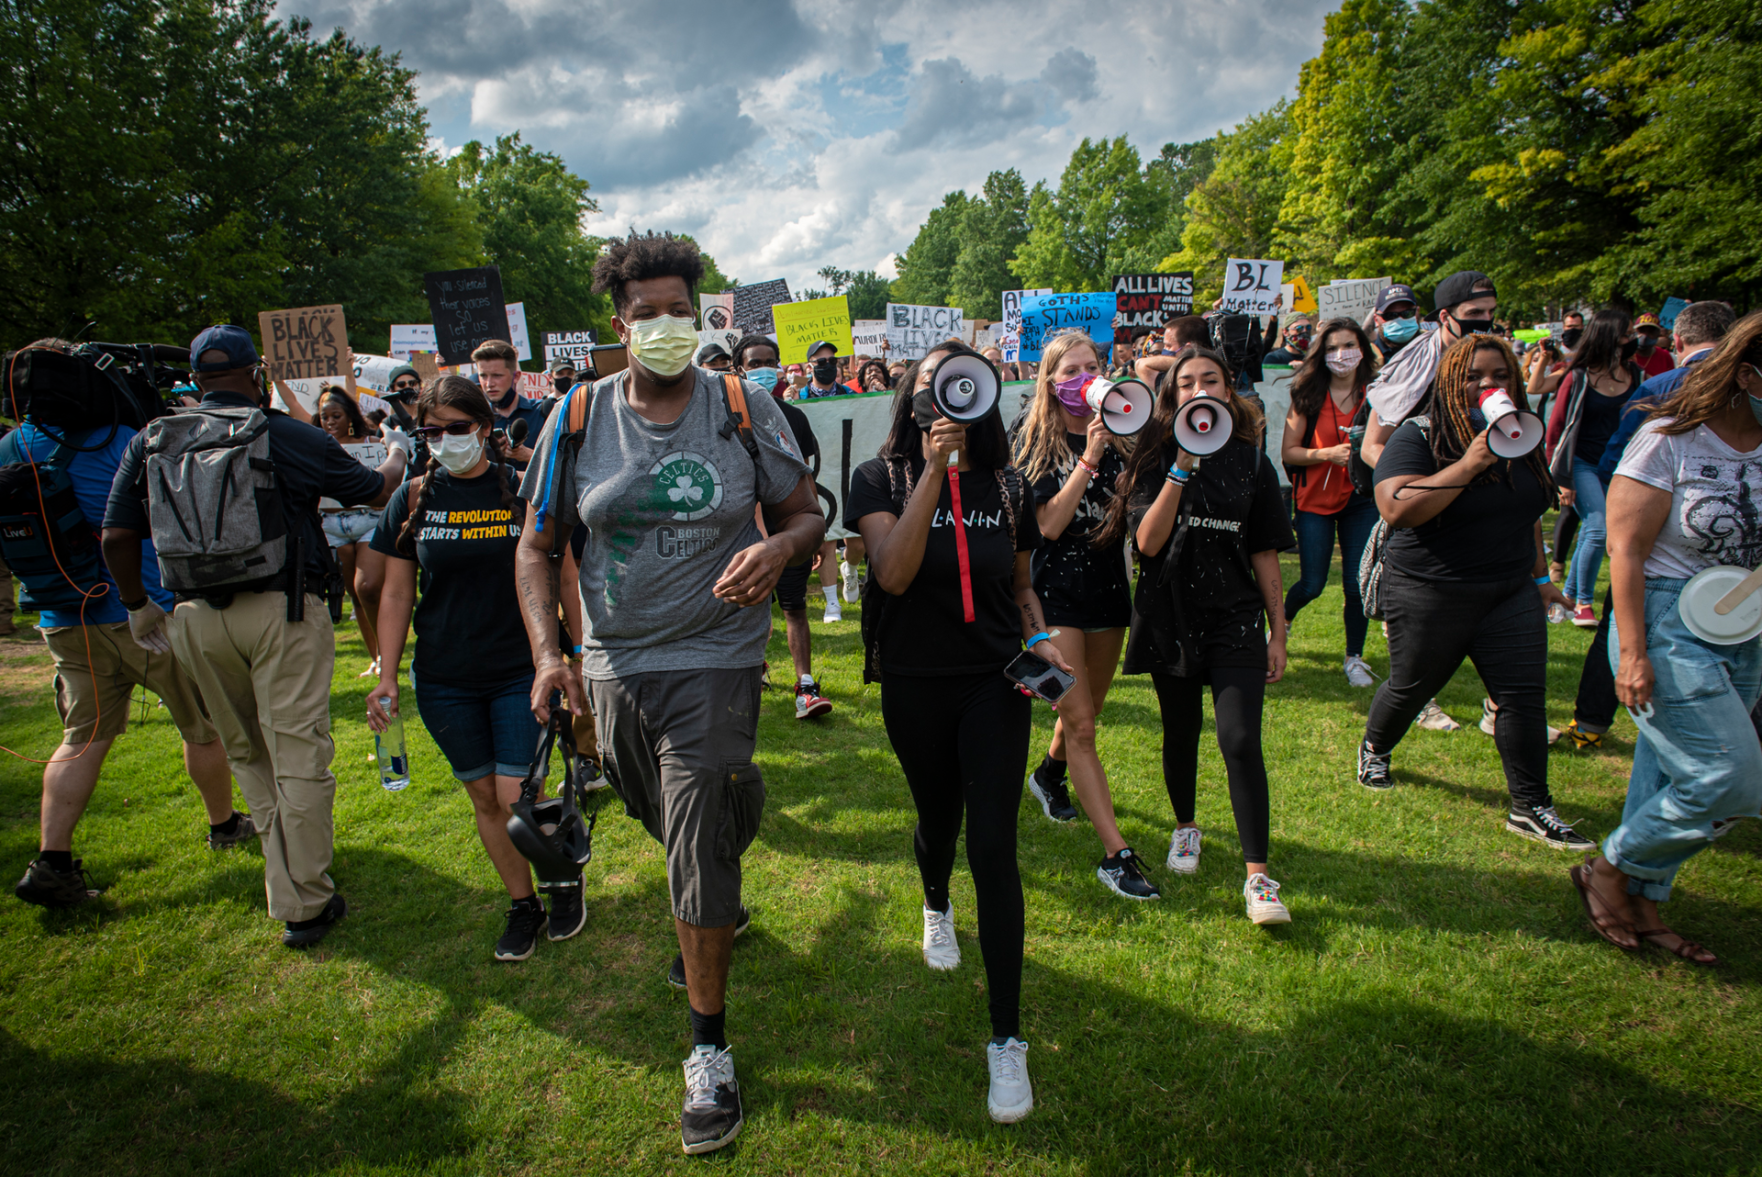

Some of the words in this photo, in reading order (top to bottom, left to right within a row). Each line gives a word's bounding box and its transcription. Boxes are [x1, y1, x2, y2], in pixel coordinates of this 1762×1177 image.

[1114, 277, 1146, 294] ALL
[1147, 276, 1193, 295] LIVES
[1039, 294, 1089, 307] GOTHS
[1117, 294, 1162, 311] CAN'T
[1163, 295, 1193, 304] MATTER
[786, 320, 819, 336] BLACK
[822, 315, 850, 328] LIVES
[892, 305, 961, 331] BLACK
[1042, 307, 1101, 327] STANDS
[1116, 311, 1164, 328] BLACK
[271, 315, 336, 342] BLACK
[796, 328, 838, 344] MATTER
[547, 331, 591, 344] BLACK
[273, 341, 339, 361] LIVES
[552, 346, 589, 358] LIVES
[270, 359, 339, 381] MATTER
[659, 462, 709, 485] CELTICS
[425, 510, 447, 523] THE
[420, 526, 460, 540] STARTS
[462, 525, 507, 539] WITHIN
[678, 527, 721, 539] BOSTON
